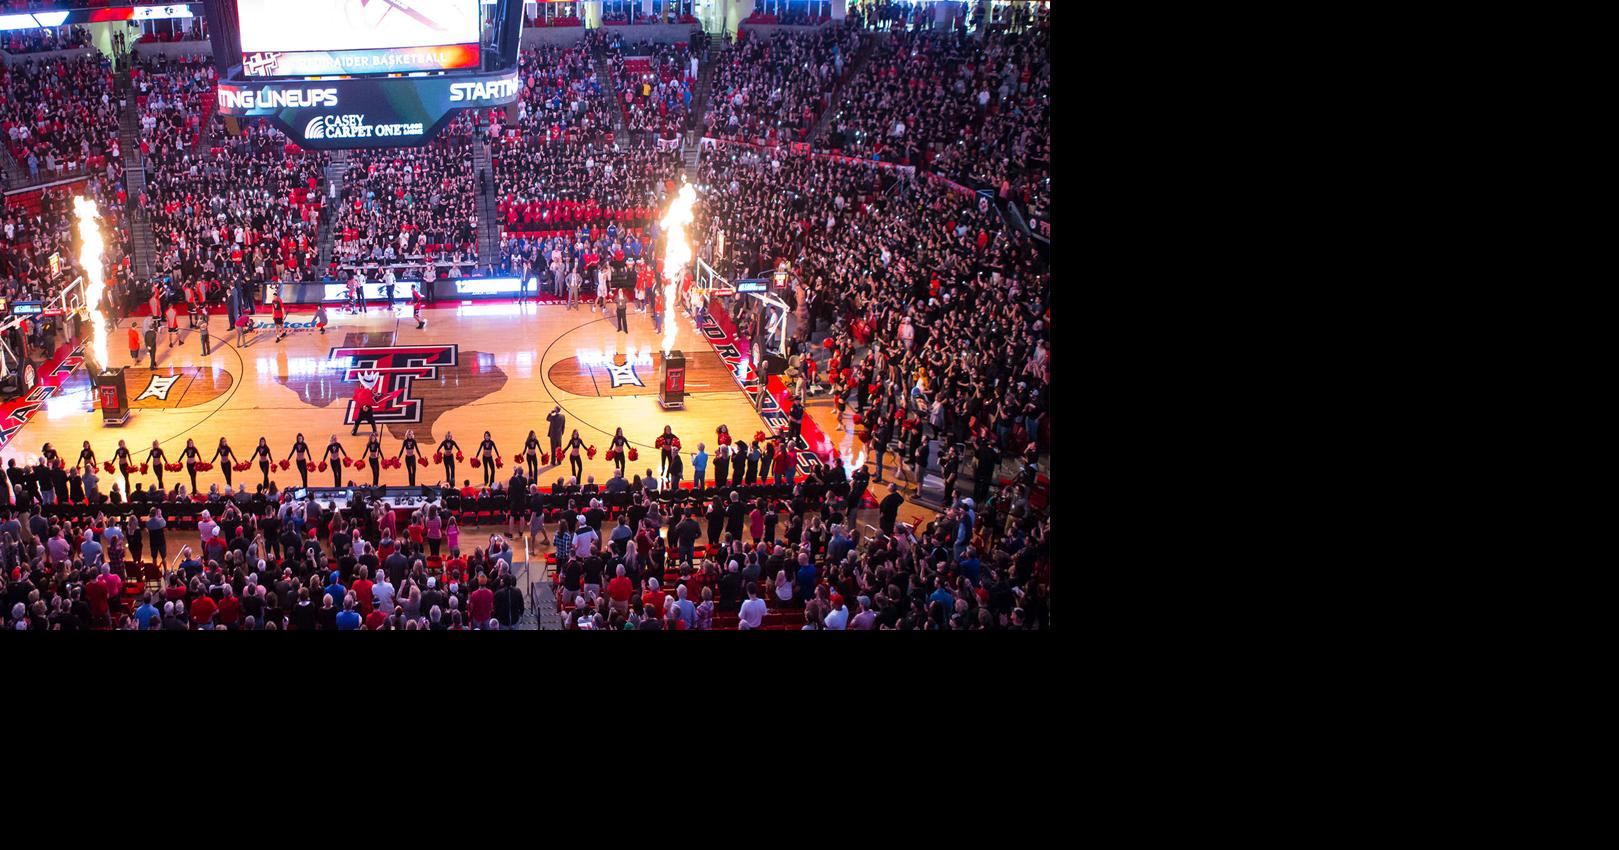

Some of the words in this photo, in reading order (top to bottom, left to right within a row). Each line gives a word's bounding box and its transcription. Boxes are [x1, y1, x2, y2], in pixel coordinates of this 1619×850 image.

[328, 56, 369, 68] RAIDER
[372, 52, 446, 66] BASKETBALL
[256, 88, 338, 108] LINEUPS
[325, 115, 364, 127] CASEY
[325, 125, 373, 138] CARPET
[375, 124, 402, 136] ONE
